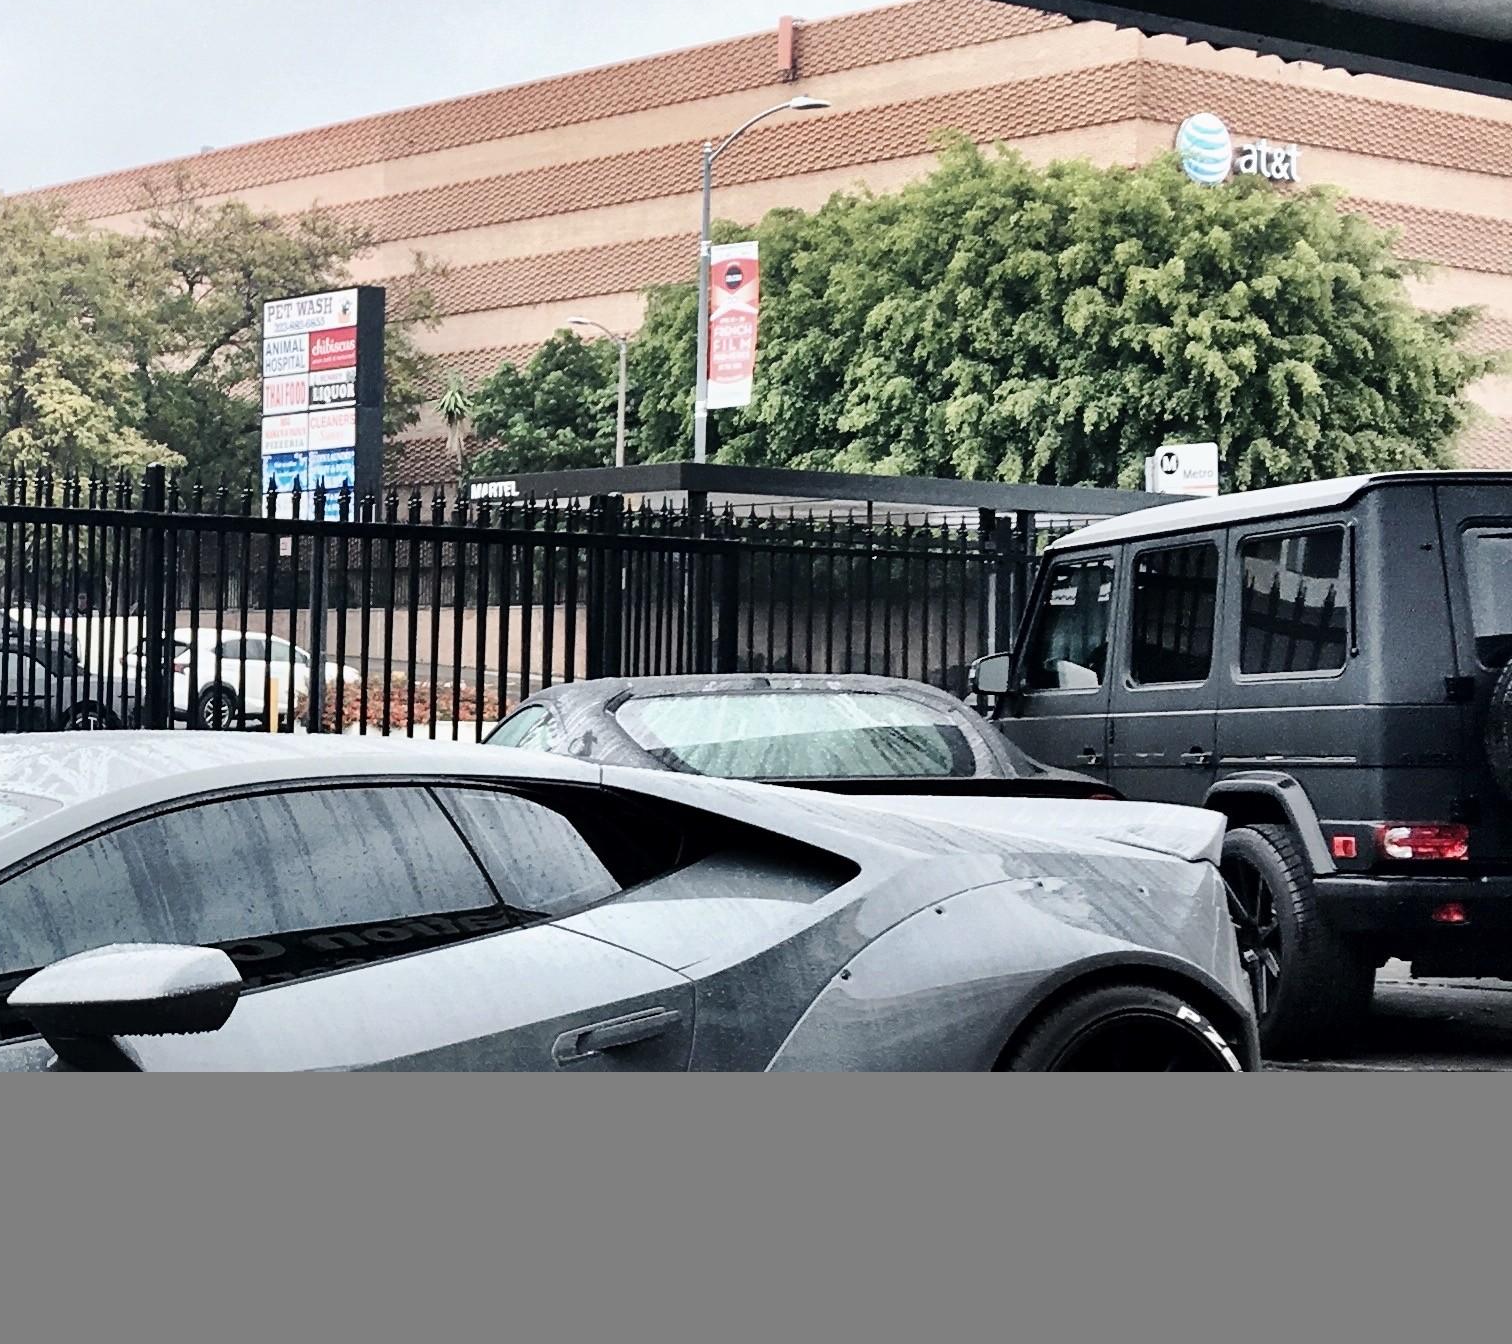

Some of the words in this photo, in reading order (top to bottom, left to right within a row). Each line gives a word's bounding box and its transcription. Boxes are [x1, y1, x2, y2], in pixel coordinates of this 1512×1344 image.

[1236, 138, 1300, 183] at&t
[267, 302, 293, 322] PET
[296, 297, 333, 316] WASH
[265, 338, 305, 356] ANIMAL
[713, 337, 752, 353] FILM
[265, 355, 305, 372] HOSPITAL
[265, 383, 285, 409] THAI
[286, 381, 306, 406] FOOD
[312, 383, 356, 406] LIQUOR
[310, 414, 356, 430] CLEANERS
[1183, 469, 1214, 479] Metro
[470, 480, 520, 500] MARTEL
